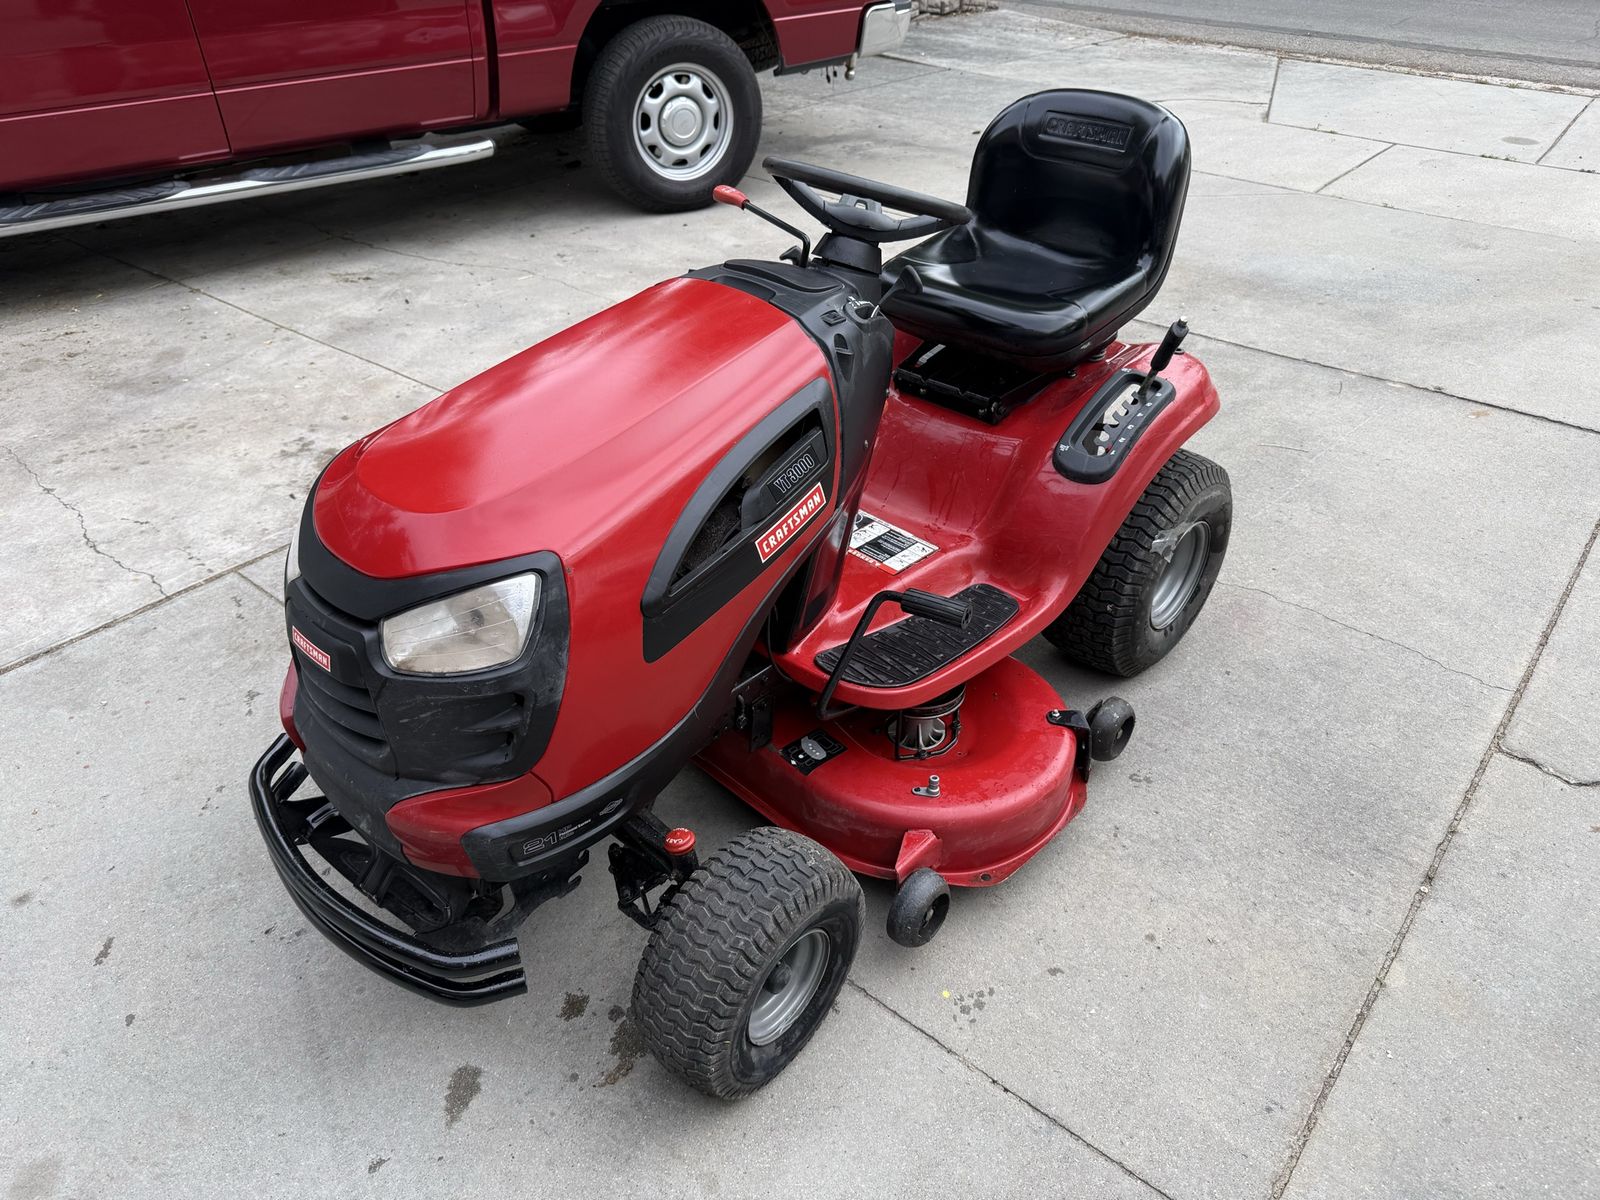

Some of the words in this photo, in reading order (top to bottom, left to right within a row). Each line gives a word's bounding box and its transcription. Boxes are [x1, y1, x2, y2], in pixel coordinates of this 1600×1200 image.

[1046, 117, 1127, 145] CRAFTSMAN
[762, 492, 821, 553] CRAFTSMAN
[294, 632, 328, 666] CRAFTSMAN
[523, 831, 558, 855] 21
